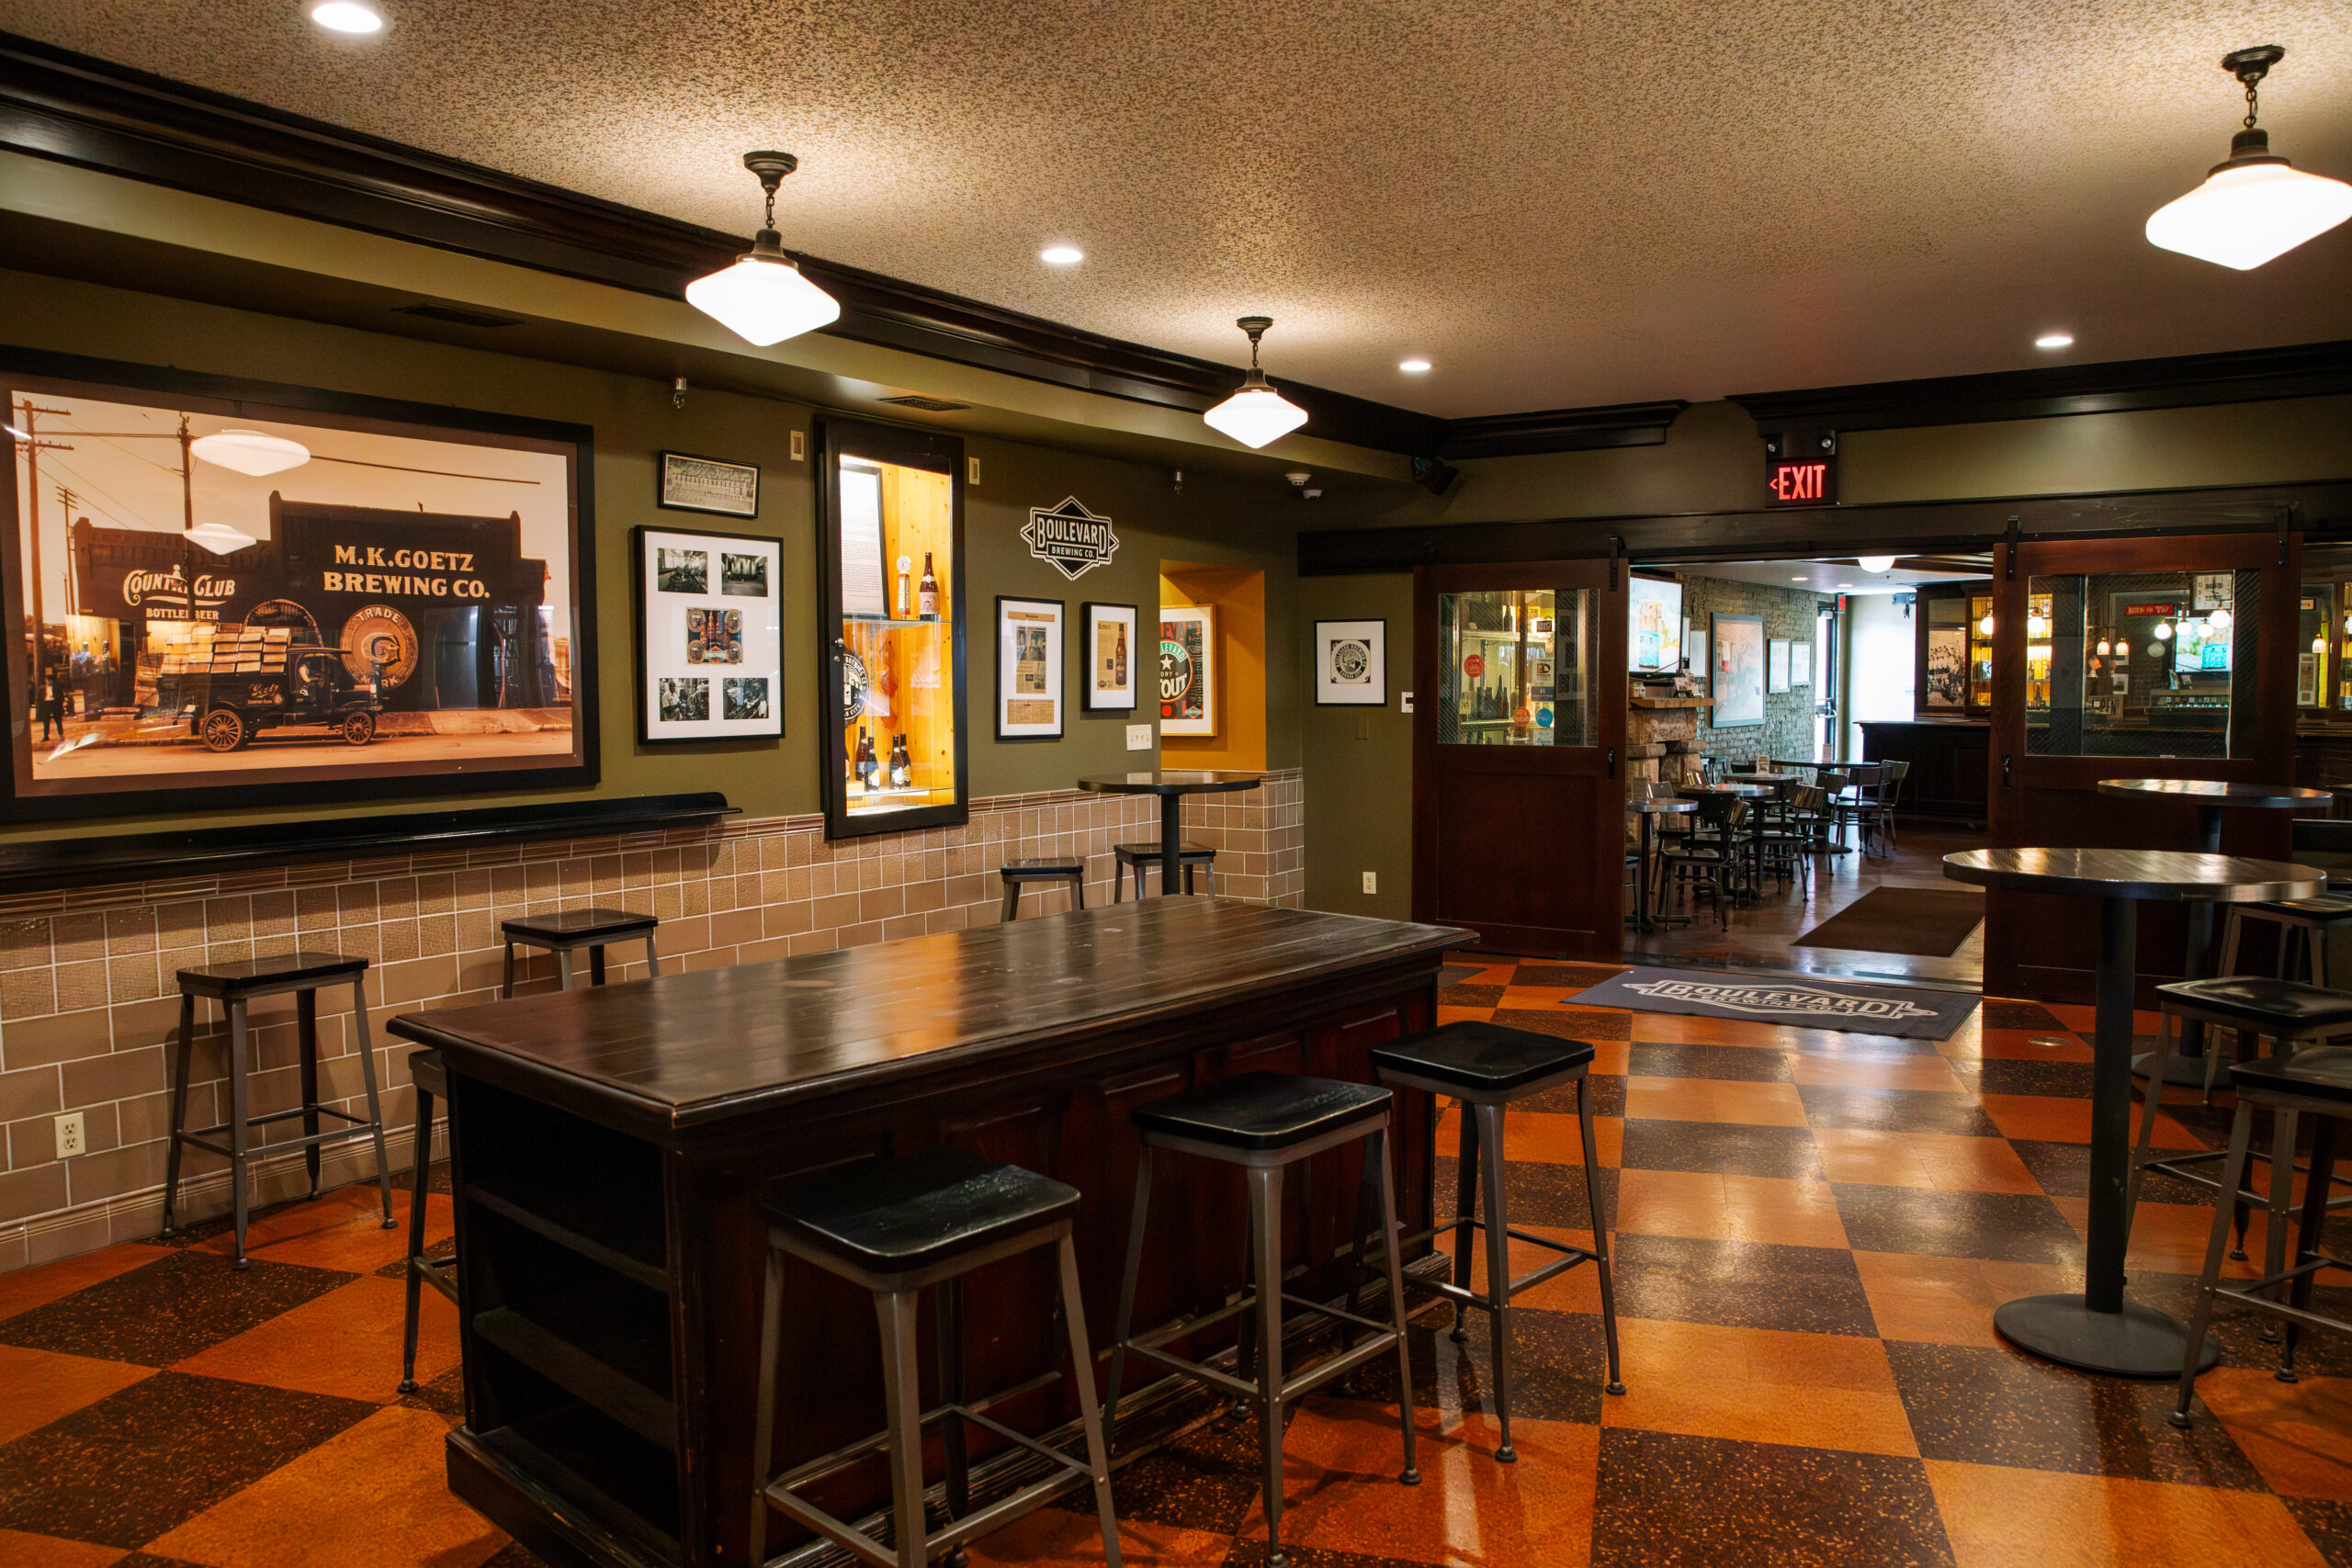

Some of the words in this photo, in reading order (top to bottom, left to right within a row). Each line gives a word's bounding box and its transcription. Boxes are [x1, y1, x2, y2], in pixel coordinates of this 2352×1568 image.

[1779, 465, 1826, 500] EXIT
[1036, 517, 1107, 555] BOULEVARD
[1051, 546, 1083, 558] BREWING
[1084, 549, 1095, 558] CO.
[194, 574, 236, 597] CLUB
[323, 571, 447, 596] BREWING
[453, 580, 491, 598] CO.
[195, 610, 220, 620] BEER
[356, 606, 401, 623] TRADE
[360, 674, 399, 688] MRK
[1160, 672, 1187, 699] OUT
[850, 702, 861, 716] CITY
[1663, 984, 1891, 1014] BOULEVARD
[1701, 995, 1797, 1008] BREWING
